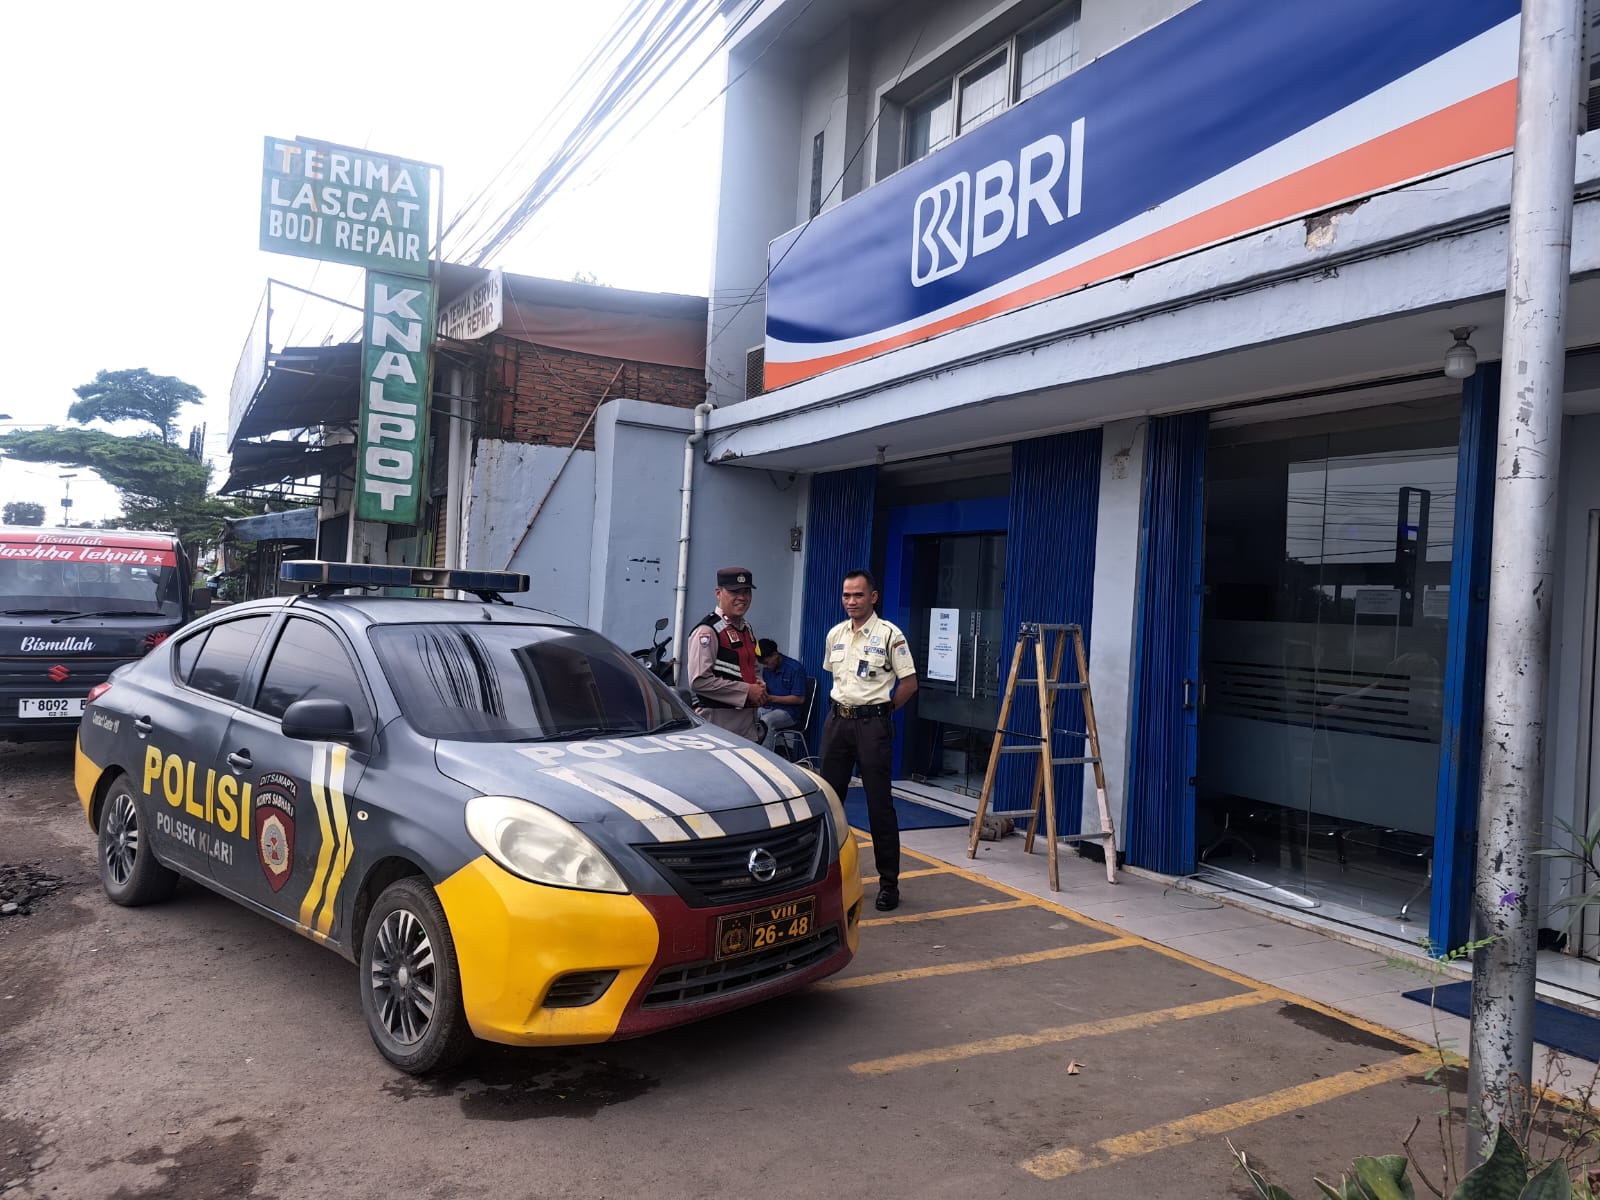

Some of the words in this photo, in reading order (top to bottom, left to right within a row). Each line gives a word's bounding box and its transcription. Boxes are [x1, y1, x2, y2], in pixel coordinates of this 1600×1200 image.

[274, 143, 418, 198] TERIMA
[973, 116, 1086, 258] BRI
[269, 209, 323, 245] BODI
[335, 220, 420, 262] REPAIR
[450, 295, 471, 326] TERIMA
[473, 277, 499, 310] SERVIS
[467, 302, 494, 336] REPAIR
[364, 283, 423, 511] KNALPOT
[35, 534, 105, 546] Bismillah
[79, 547, 148, 564] Teknik
[20, 636, 96, 652] Bismillah
[22, 700, 29, 711] T
[38, 700, 69, 711] 8092
[515, 733, 739, 767] POLISI
[143, 744, 252, 840] POLISI
[157, 811, 197, 848] POLSEK
[199, 831, 233, 866] KLARI
[771, 904, 797, 920] VIII
